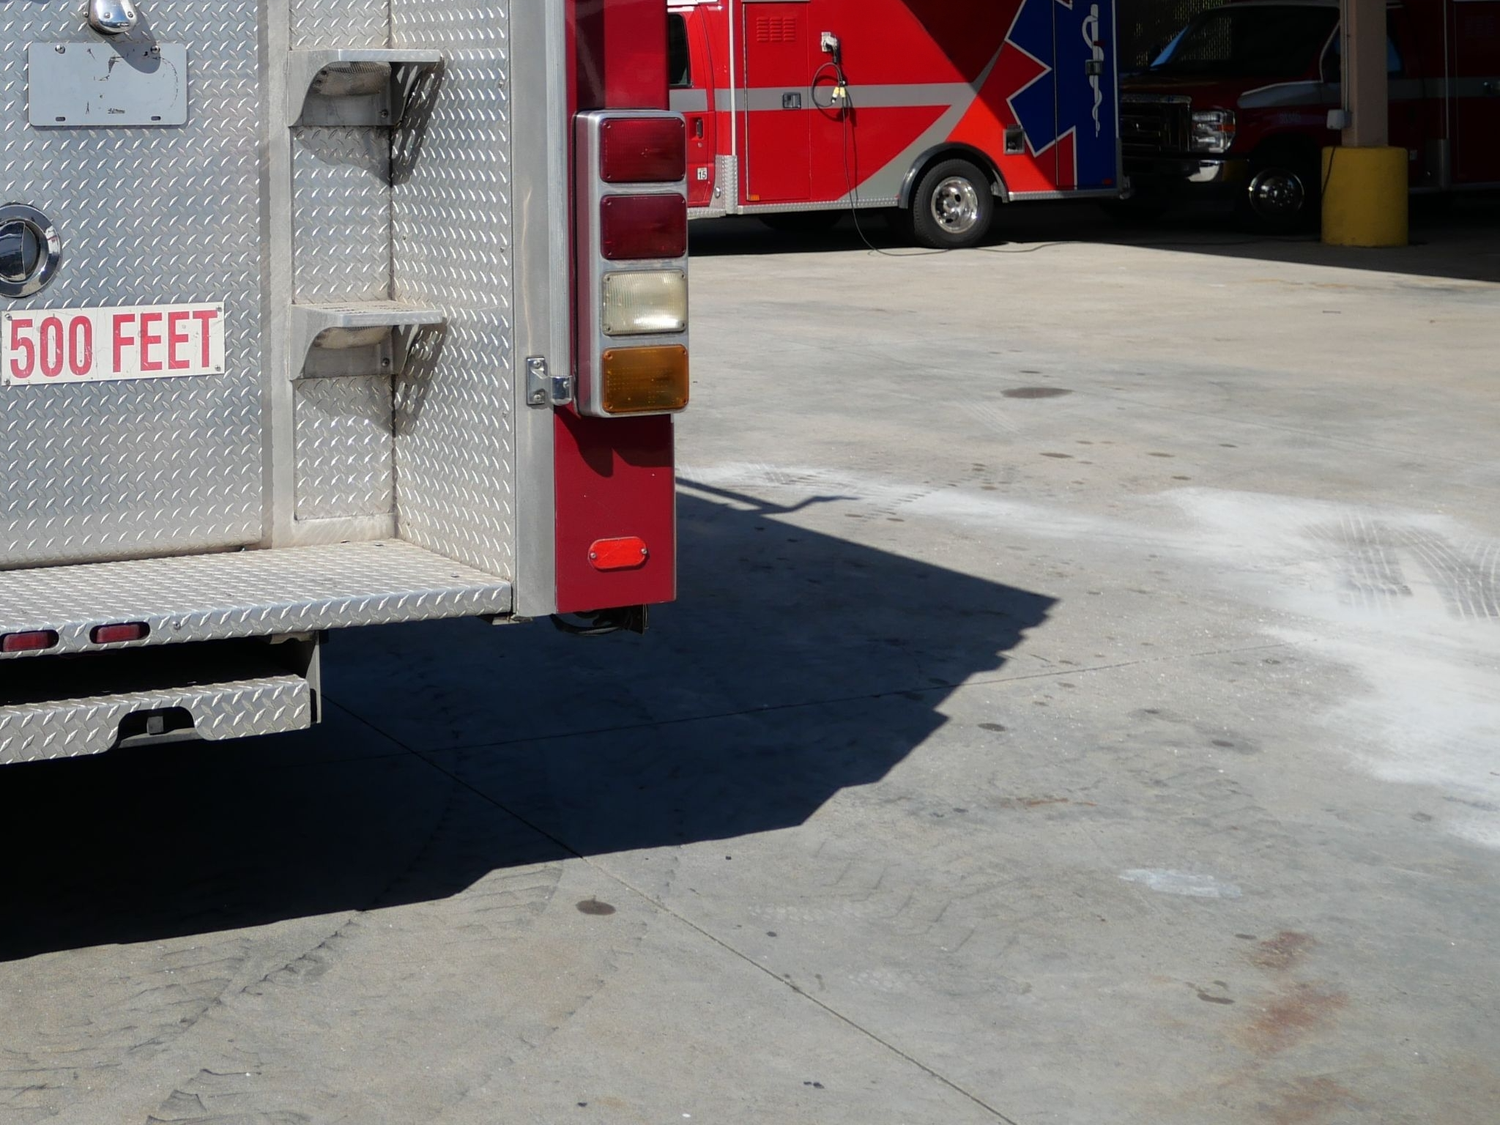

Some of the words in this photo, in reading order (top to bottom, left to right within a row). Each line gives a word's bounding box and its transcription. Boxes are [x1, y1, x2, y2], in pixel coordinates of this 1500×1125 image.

[699, 171, 706, 179] 15
[10, 315, 92, 378] 500
[112, 309, 218, 373] FEET
